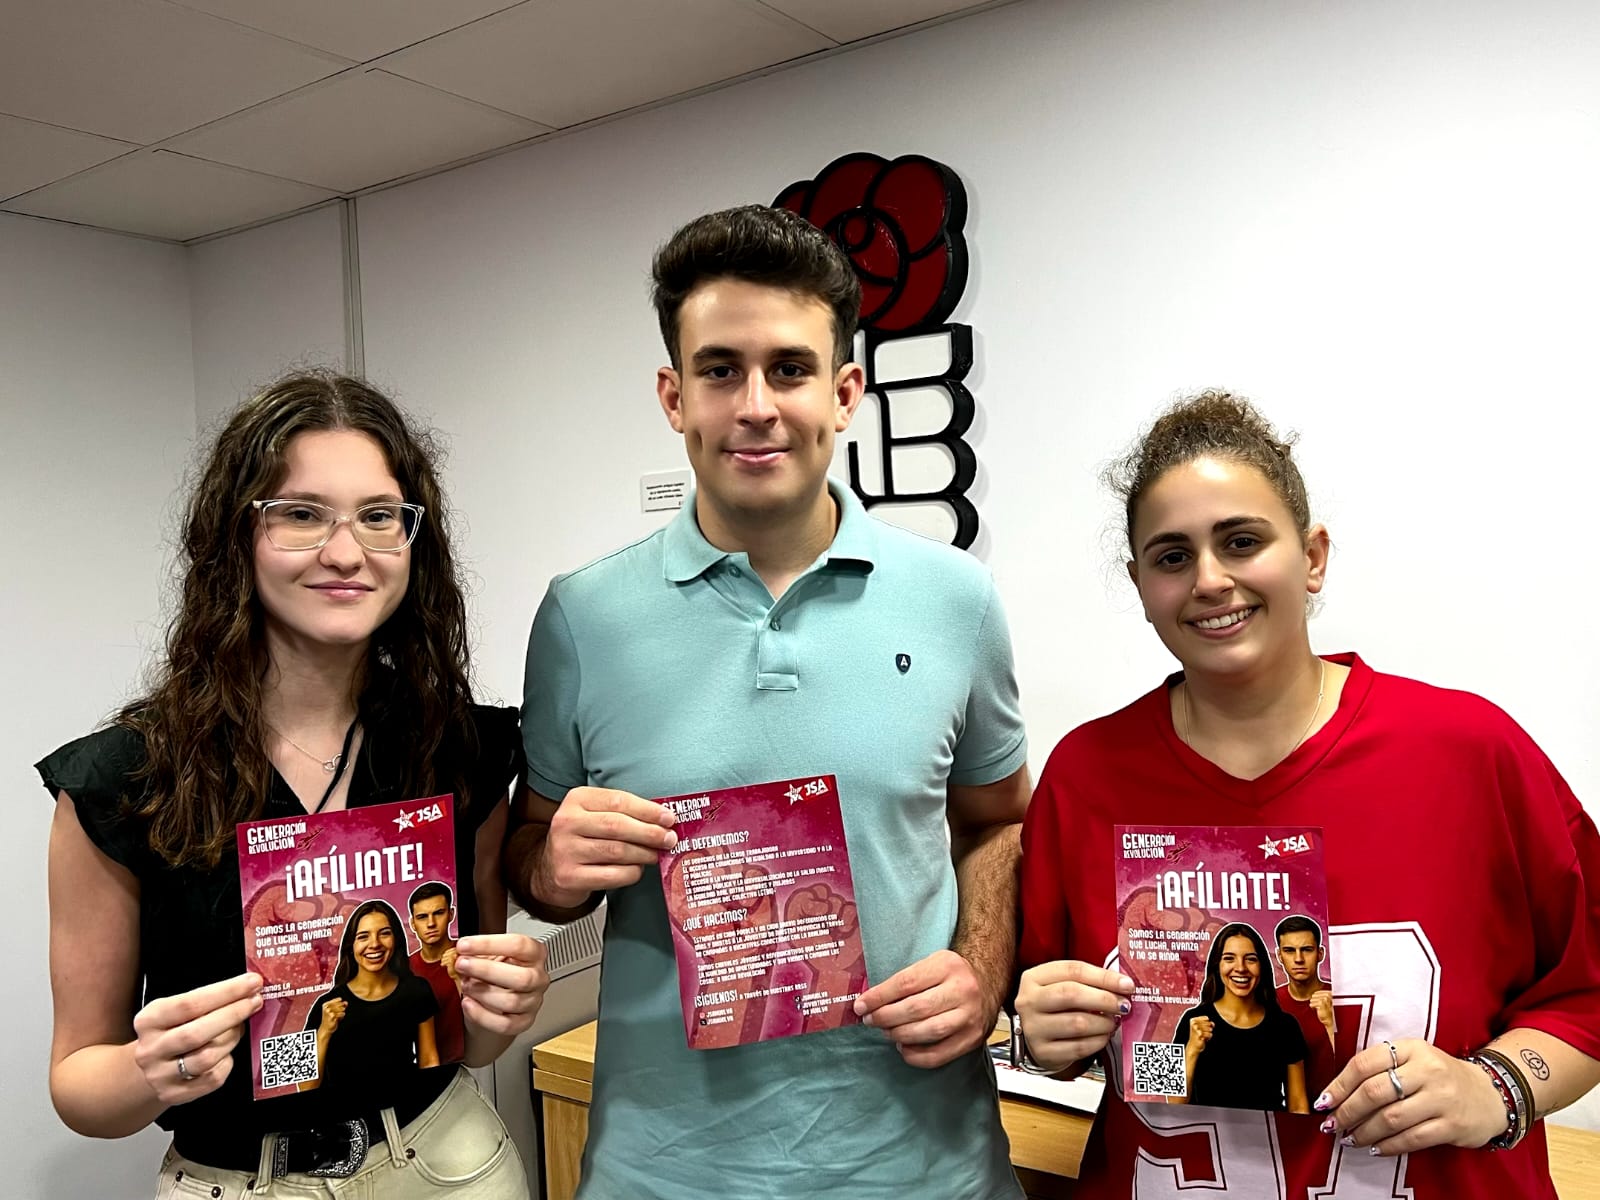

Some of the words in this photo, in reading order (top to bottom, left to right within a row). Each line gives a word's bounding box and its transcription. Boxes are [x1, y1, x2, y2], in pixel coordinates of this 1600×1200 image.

[804, 779, 828, 796] JSA
[415, 803, 442, 822] JSA
[247, 820, 306, 845] GENERACIÓN
[691, 831, 750, 850] DEFENDEMOS?
[1122, 831, 1176, 850] GENERACIÓN
[1282, 834, 1309, 852] JSA
[285, 843, 423, 903] ¡AFÍLIATE!
[1155, 861, 1291, 911] ¡AFÍLIATE!
[285, 922, 295, 932] LA
[682, 913, 704, 932] ¿QUÉ
[703, 908, 748, 927] HACEMOS?
[1155, 930, 1164, 939] LA
[694, 989, 738, 1008] ¡SÍGUENOS!
